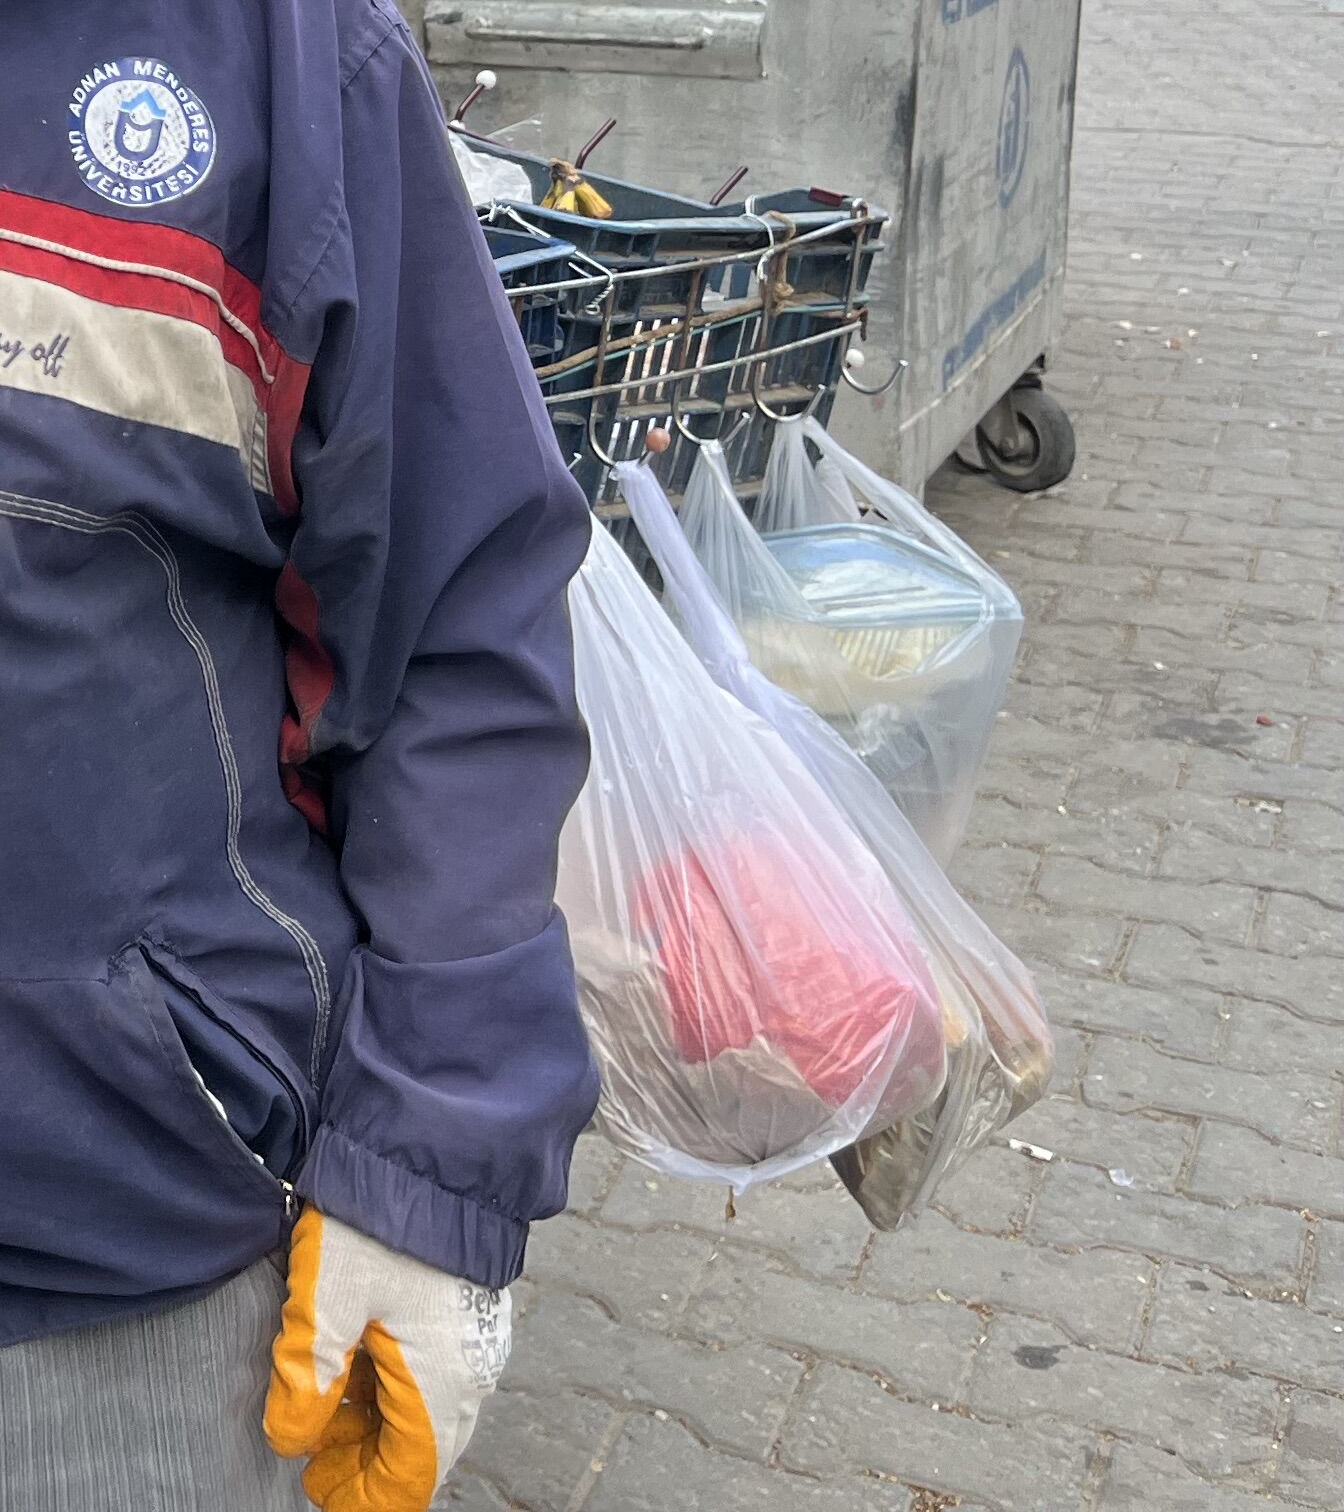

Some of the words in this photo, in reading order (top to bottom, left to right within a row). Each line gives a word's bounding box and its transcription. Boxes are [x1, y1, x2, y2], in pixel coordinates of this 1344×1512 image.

[68, 61, 121, 119] ADNAN
[133, 60, 211, 154] MENDERES
[116, 159, 147, 177] 1992
[30, 333, 70, 378] off
